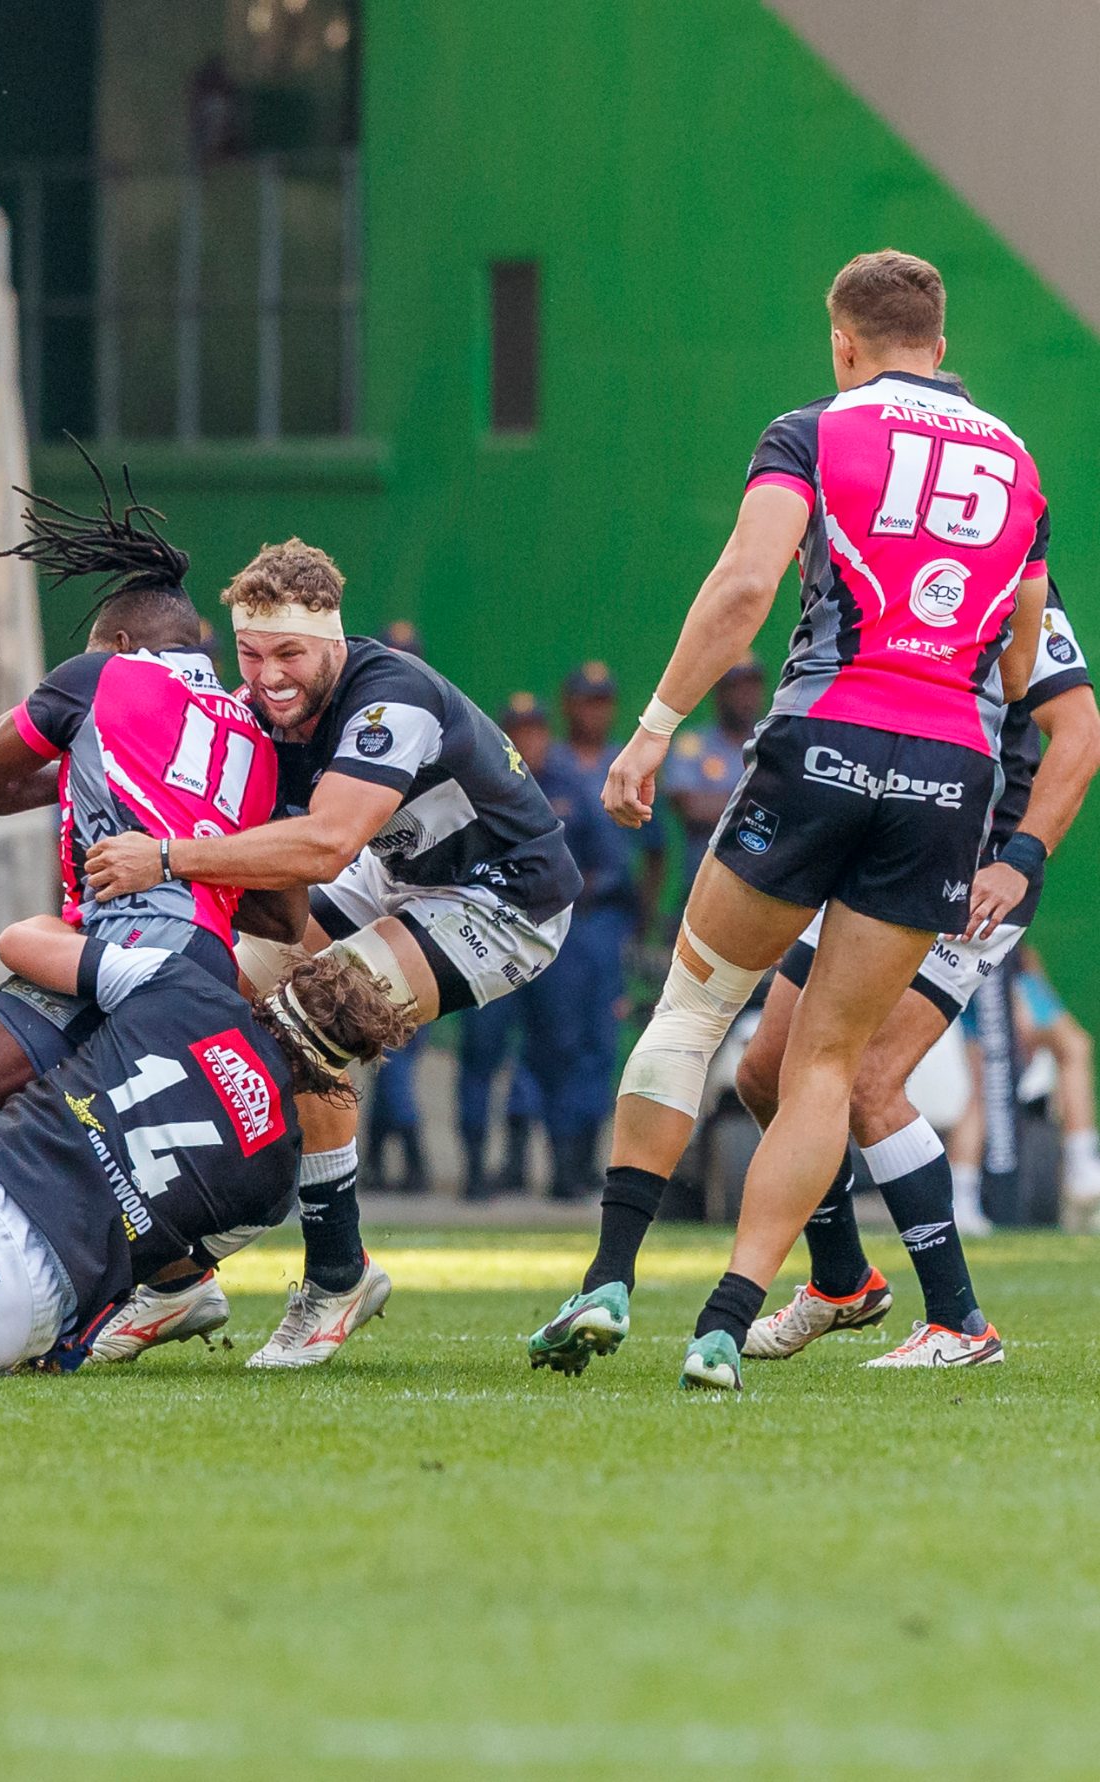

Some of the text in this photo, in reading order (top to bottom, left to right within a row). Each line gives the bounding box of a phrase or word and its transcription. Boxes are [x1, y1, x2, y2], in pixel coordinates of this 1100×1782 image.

[880, 405, 999, 440] AIRLINK
[870, 431, 1017, 547] 15
[925, 583, 962, 601] sps
[165, 701, 255, 825] 11
[364, 745, 381, 753] CUP
[804, 746, 964, 809] Citybug
[459, 924, 488, 959] SMG
[203, 1049, 255, 1144] WORKWEAR
[211, 1045, 270, 1138] JONSSON
[106, 1054, 224, 1200] 14
[906, 1236, 947, 1253] mbro
